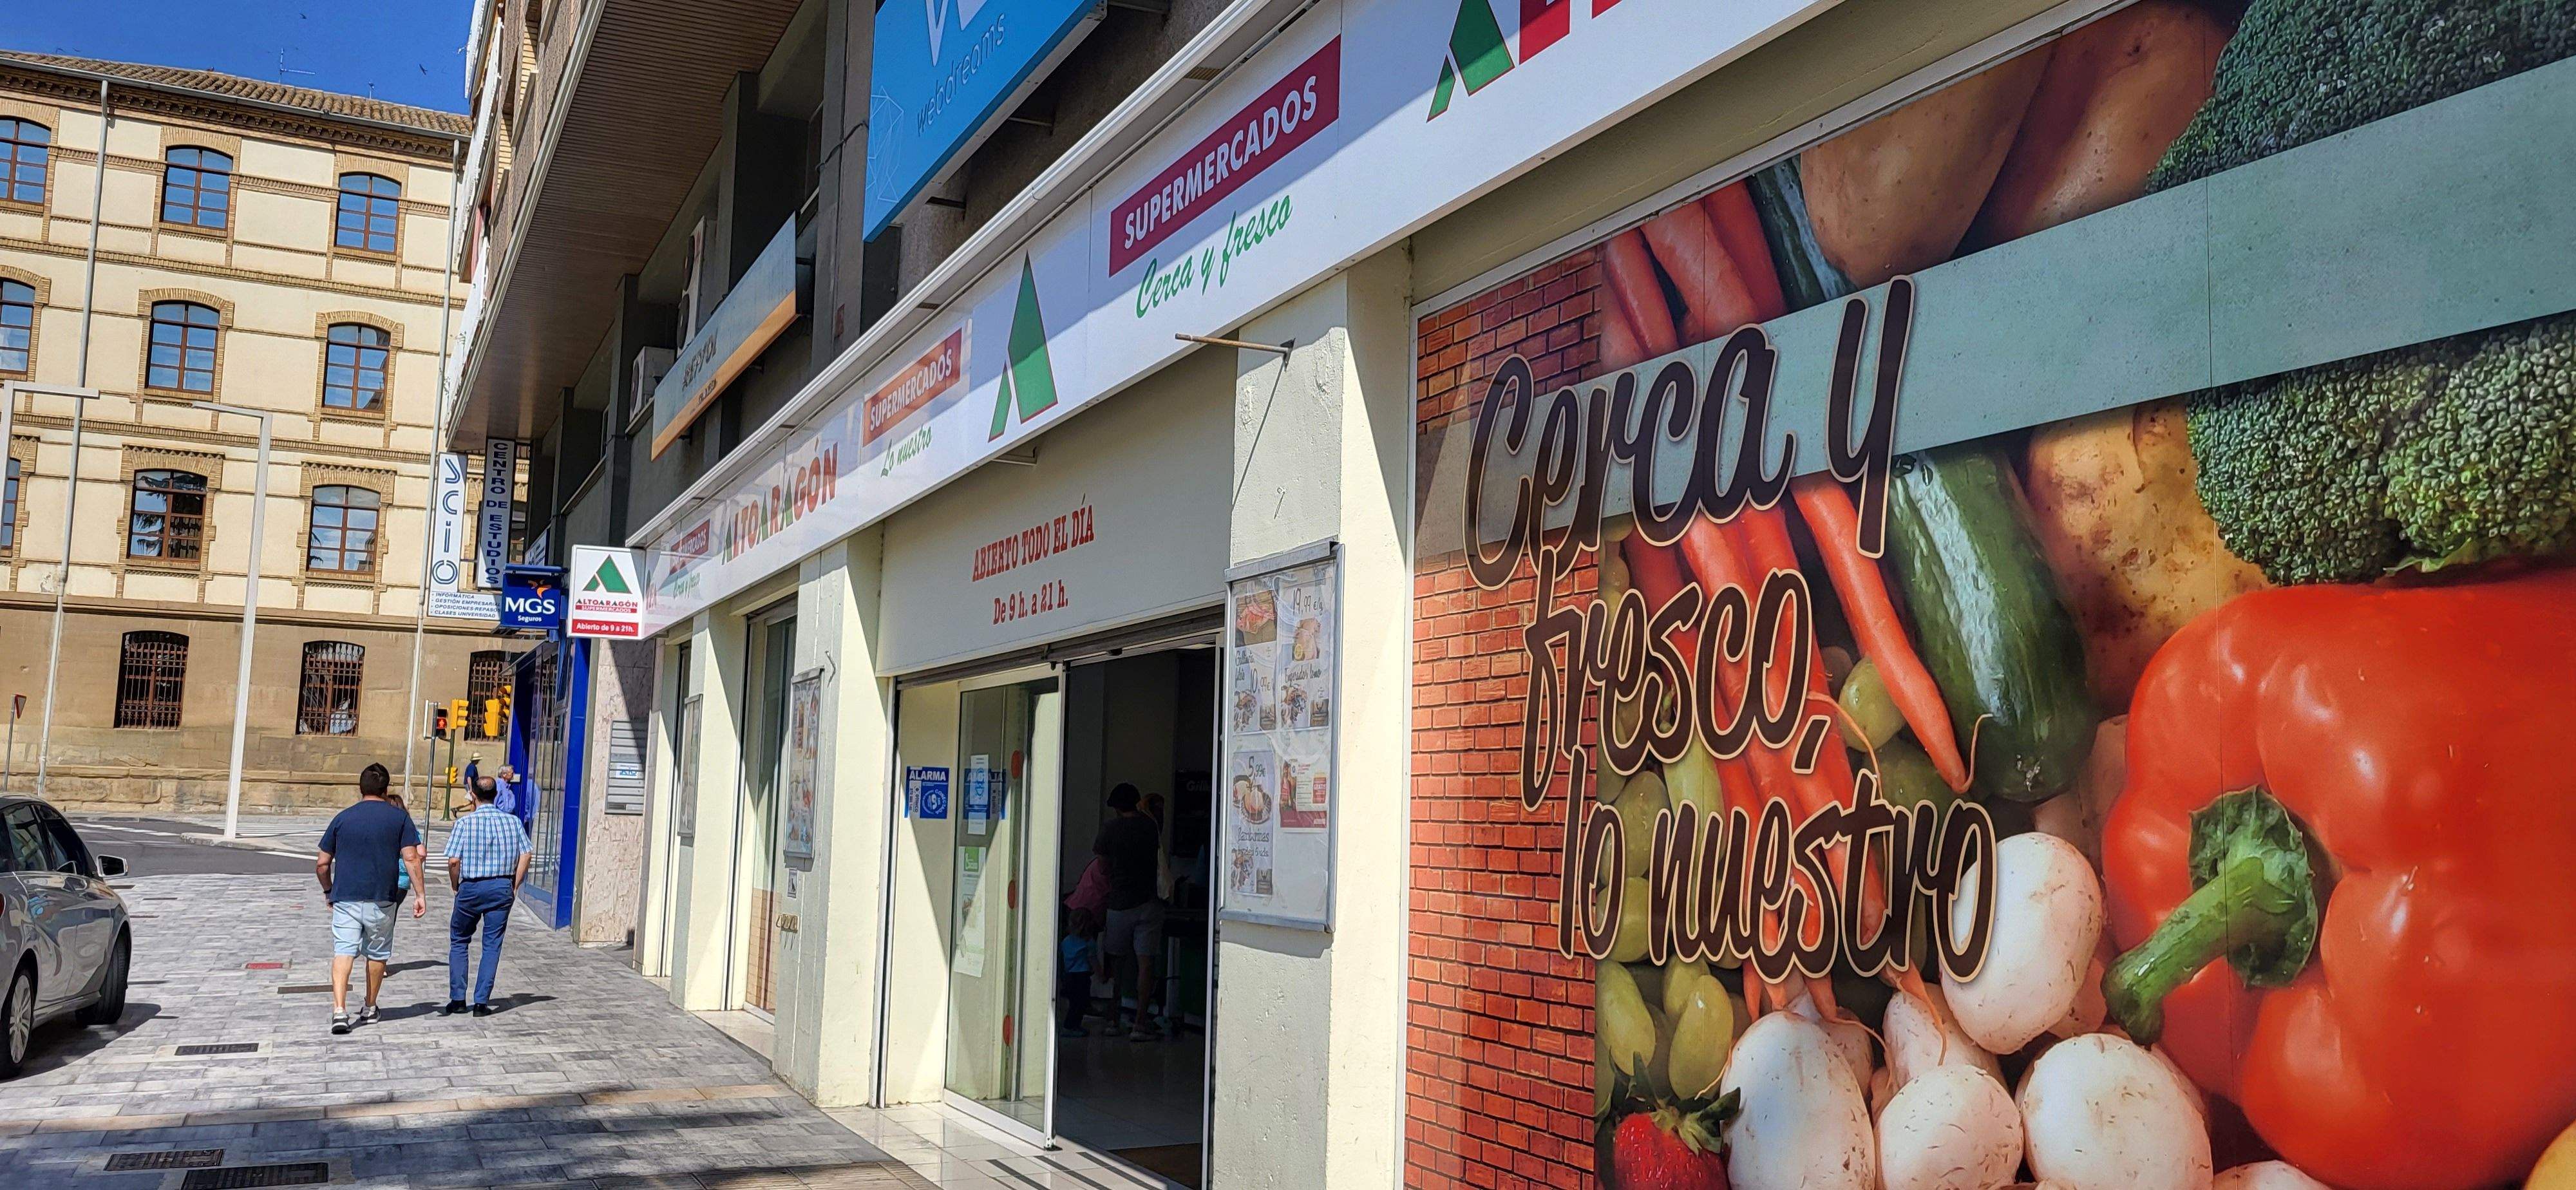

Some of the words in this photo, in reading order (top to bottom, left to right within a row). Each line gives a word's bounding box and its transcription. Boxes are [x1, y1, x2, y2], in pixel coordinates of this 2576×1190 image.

[917, 12, 1006, 137] webdreams
[1124, 75, 1317, 250] SUPERMERCADOS
[1136, 255, 1195, 319] Cerca
[1201, 245, 1216, 296] y
[1219, 194, 1293, 288] fresco
[870, 348, 952, 431] SUPERMERCADOS
[880, 439, 895, 478] Lo
[896, 424, 933, 466] nuestro
[1463, 322, 1797, 591] Cerca
[1828, 274, 1916, 560] y
[490, 442, 509, 495] CENTRO
[486, 500, 508, 509] DE
[486, 515, 503, 585] ESTUDIOS
[972, 534, 1019, 582] ABIERTO
[1021, 522, 1050, 565] TODO
[1052, 515, 1068, 554] EL
[505, 597, 556, 615] MGS
[993, 597, 1007, 625] De
[1009, 593, 1016, 621] 9
[1018, 590, 1028, 619] h.
[1031, 592, 1037, 615] a
[1041, 581, 1053, 613] 21
[1057, 579, 1068, 609] h.
[1522, 545, 1833, 811] fresco,
[909, 770, 946, 781] ALARMA
[1557, 746, 1627, 962] lo
[1651, 770, 1997, 985] nuestro
